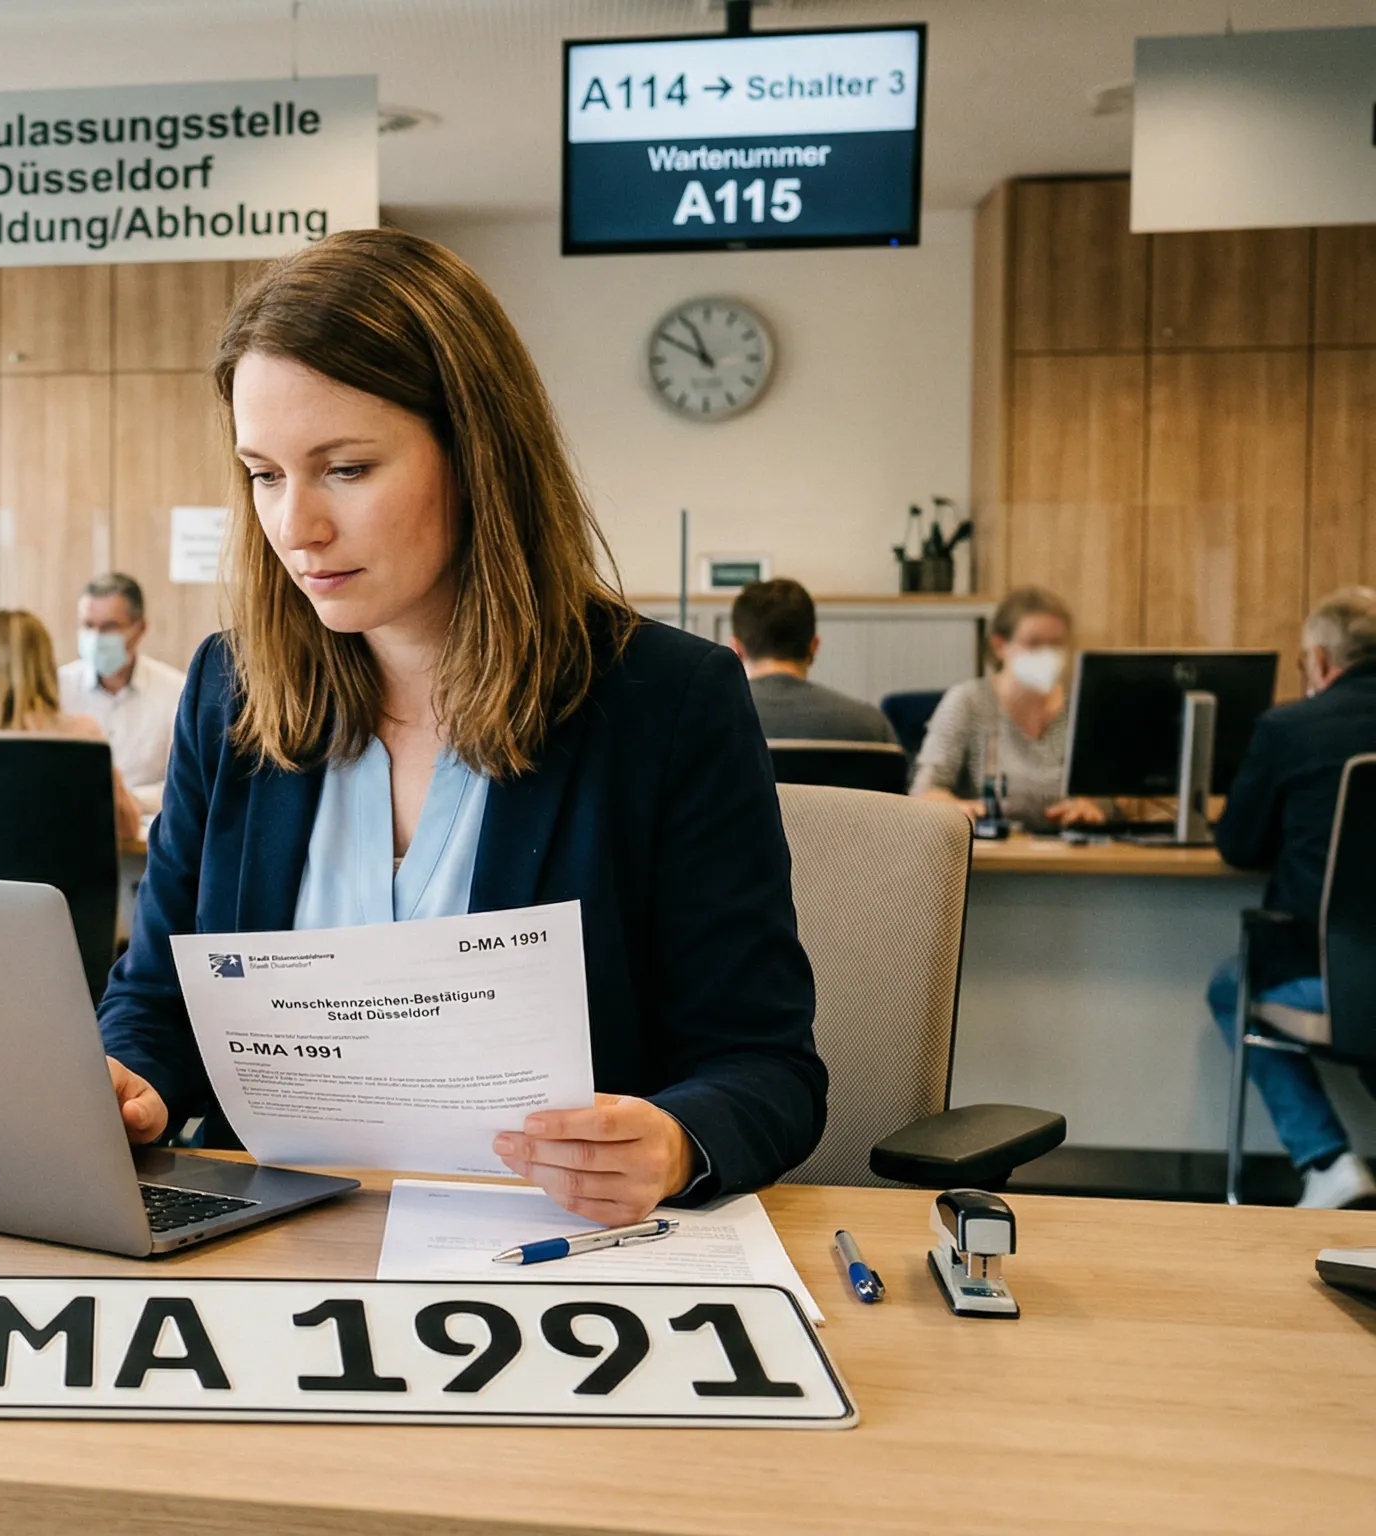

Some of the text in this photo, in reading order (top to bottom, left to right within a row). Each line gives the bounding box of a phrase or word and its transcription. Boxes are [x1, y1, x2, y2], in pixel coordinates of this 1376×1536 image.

[580, 69, 906, 112] A114 Schalter 3
[647, 144, 832, 172] Wartenummer
[672, 177, 803, 226] A115
[458, 930, 548, 953] D-MA 1991
[271, 988, 496, 1010] Wunschkennzeichen-Bestätigung
[327, 1006, 441, 1022] Stadt Düsseldorf
[228, 1040, 343, 1060] D-MA 1991
[291, 1298, 806, 1398] 1991
